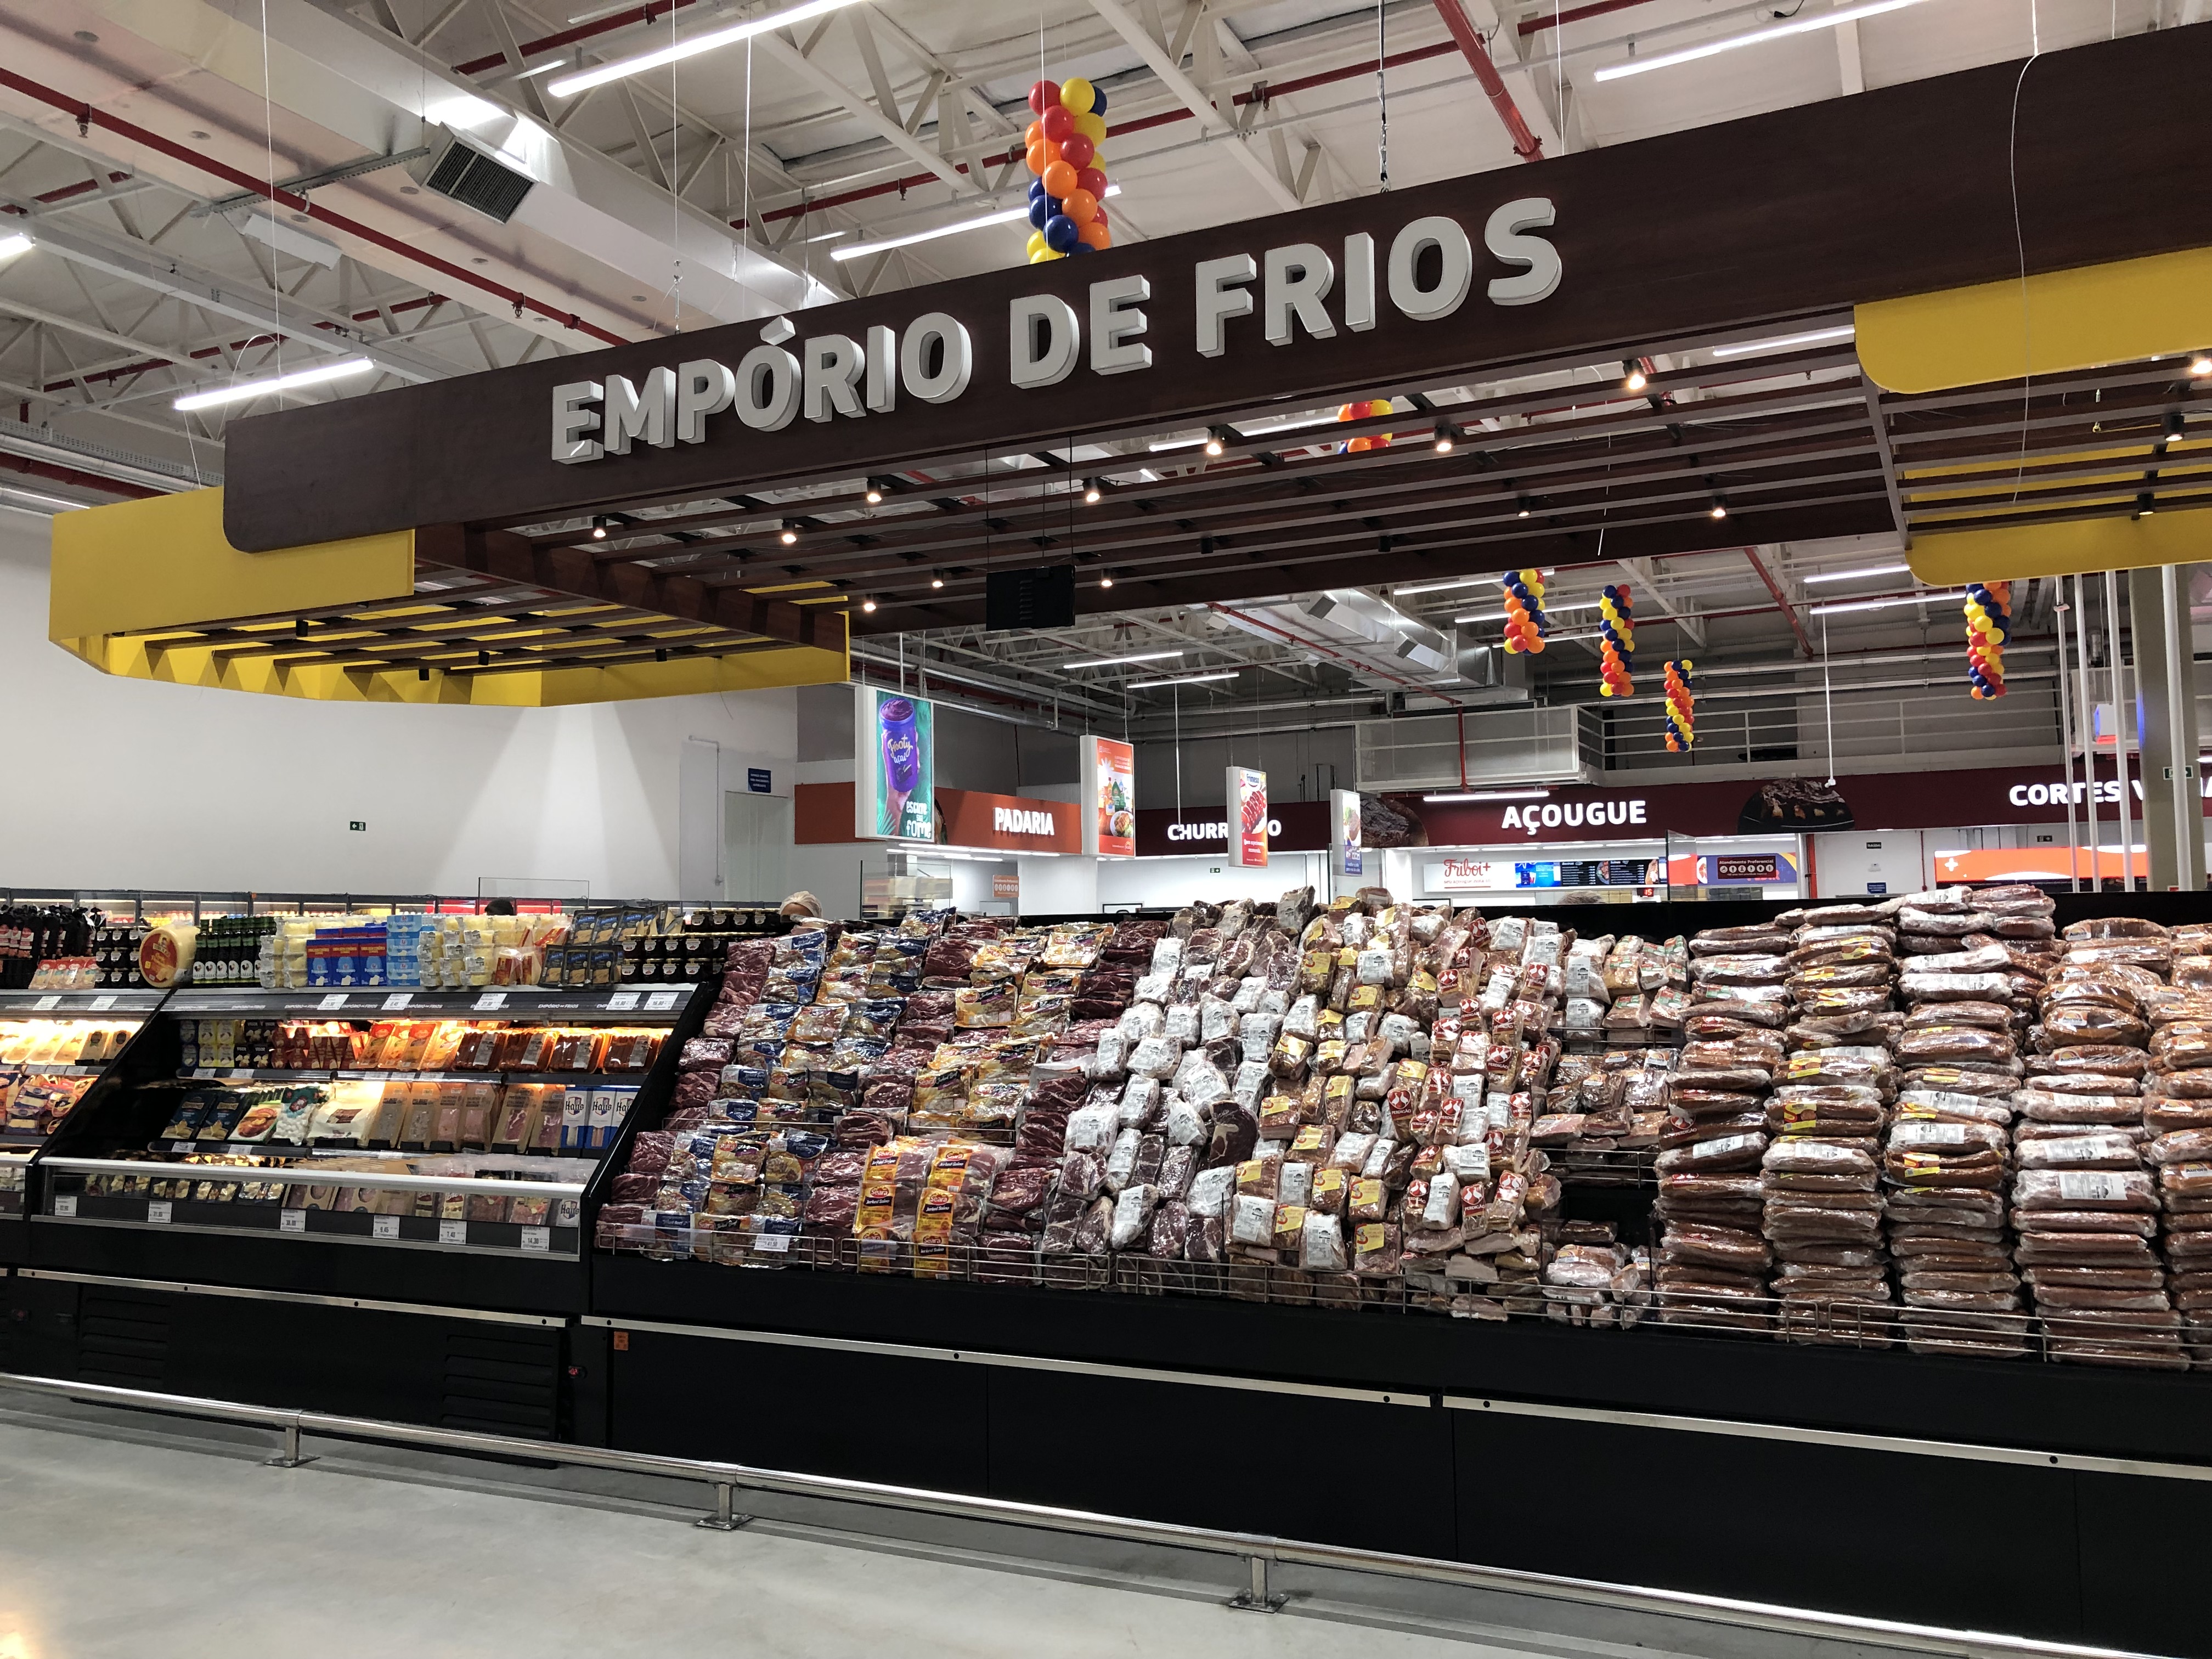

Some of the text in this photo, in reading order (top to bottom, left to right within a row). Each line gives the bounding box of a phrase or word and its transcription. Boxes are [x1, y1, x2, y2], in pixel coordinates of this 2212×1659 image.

[552, 196, 1564, 464] EMPÓRIO DE FRIOS
[887, 734, 913, 759] Frooty
[1246, 774, 1260, 783] Frimesa
[2009, 781, 2121, 806] CORTES
[993, 807, 1055, 836] PADARIA
[1167, 819, 1282, 841] CHURRO
[1502, 800, 1647, 836] AÇOUGUE
[565, 1101, 584, 1110] Haus
[592, 1101, 612, 1111] Haus
